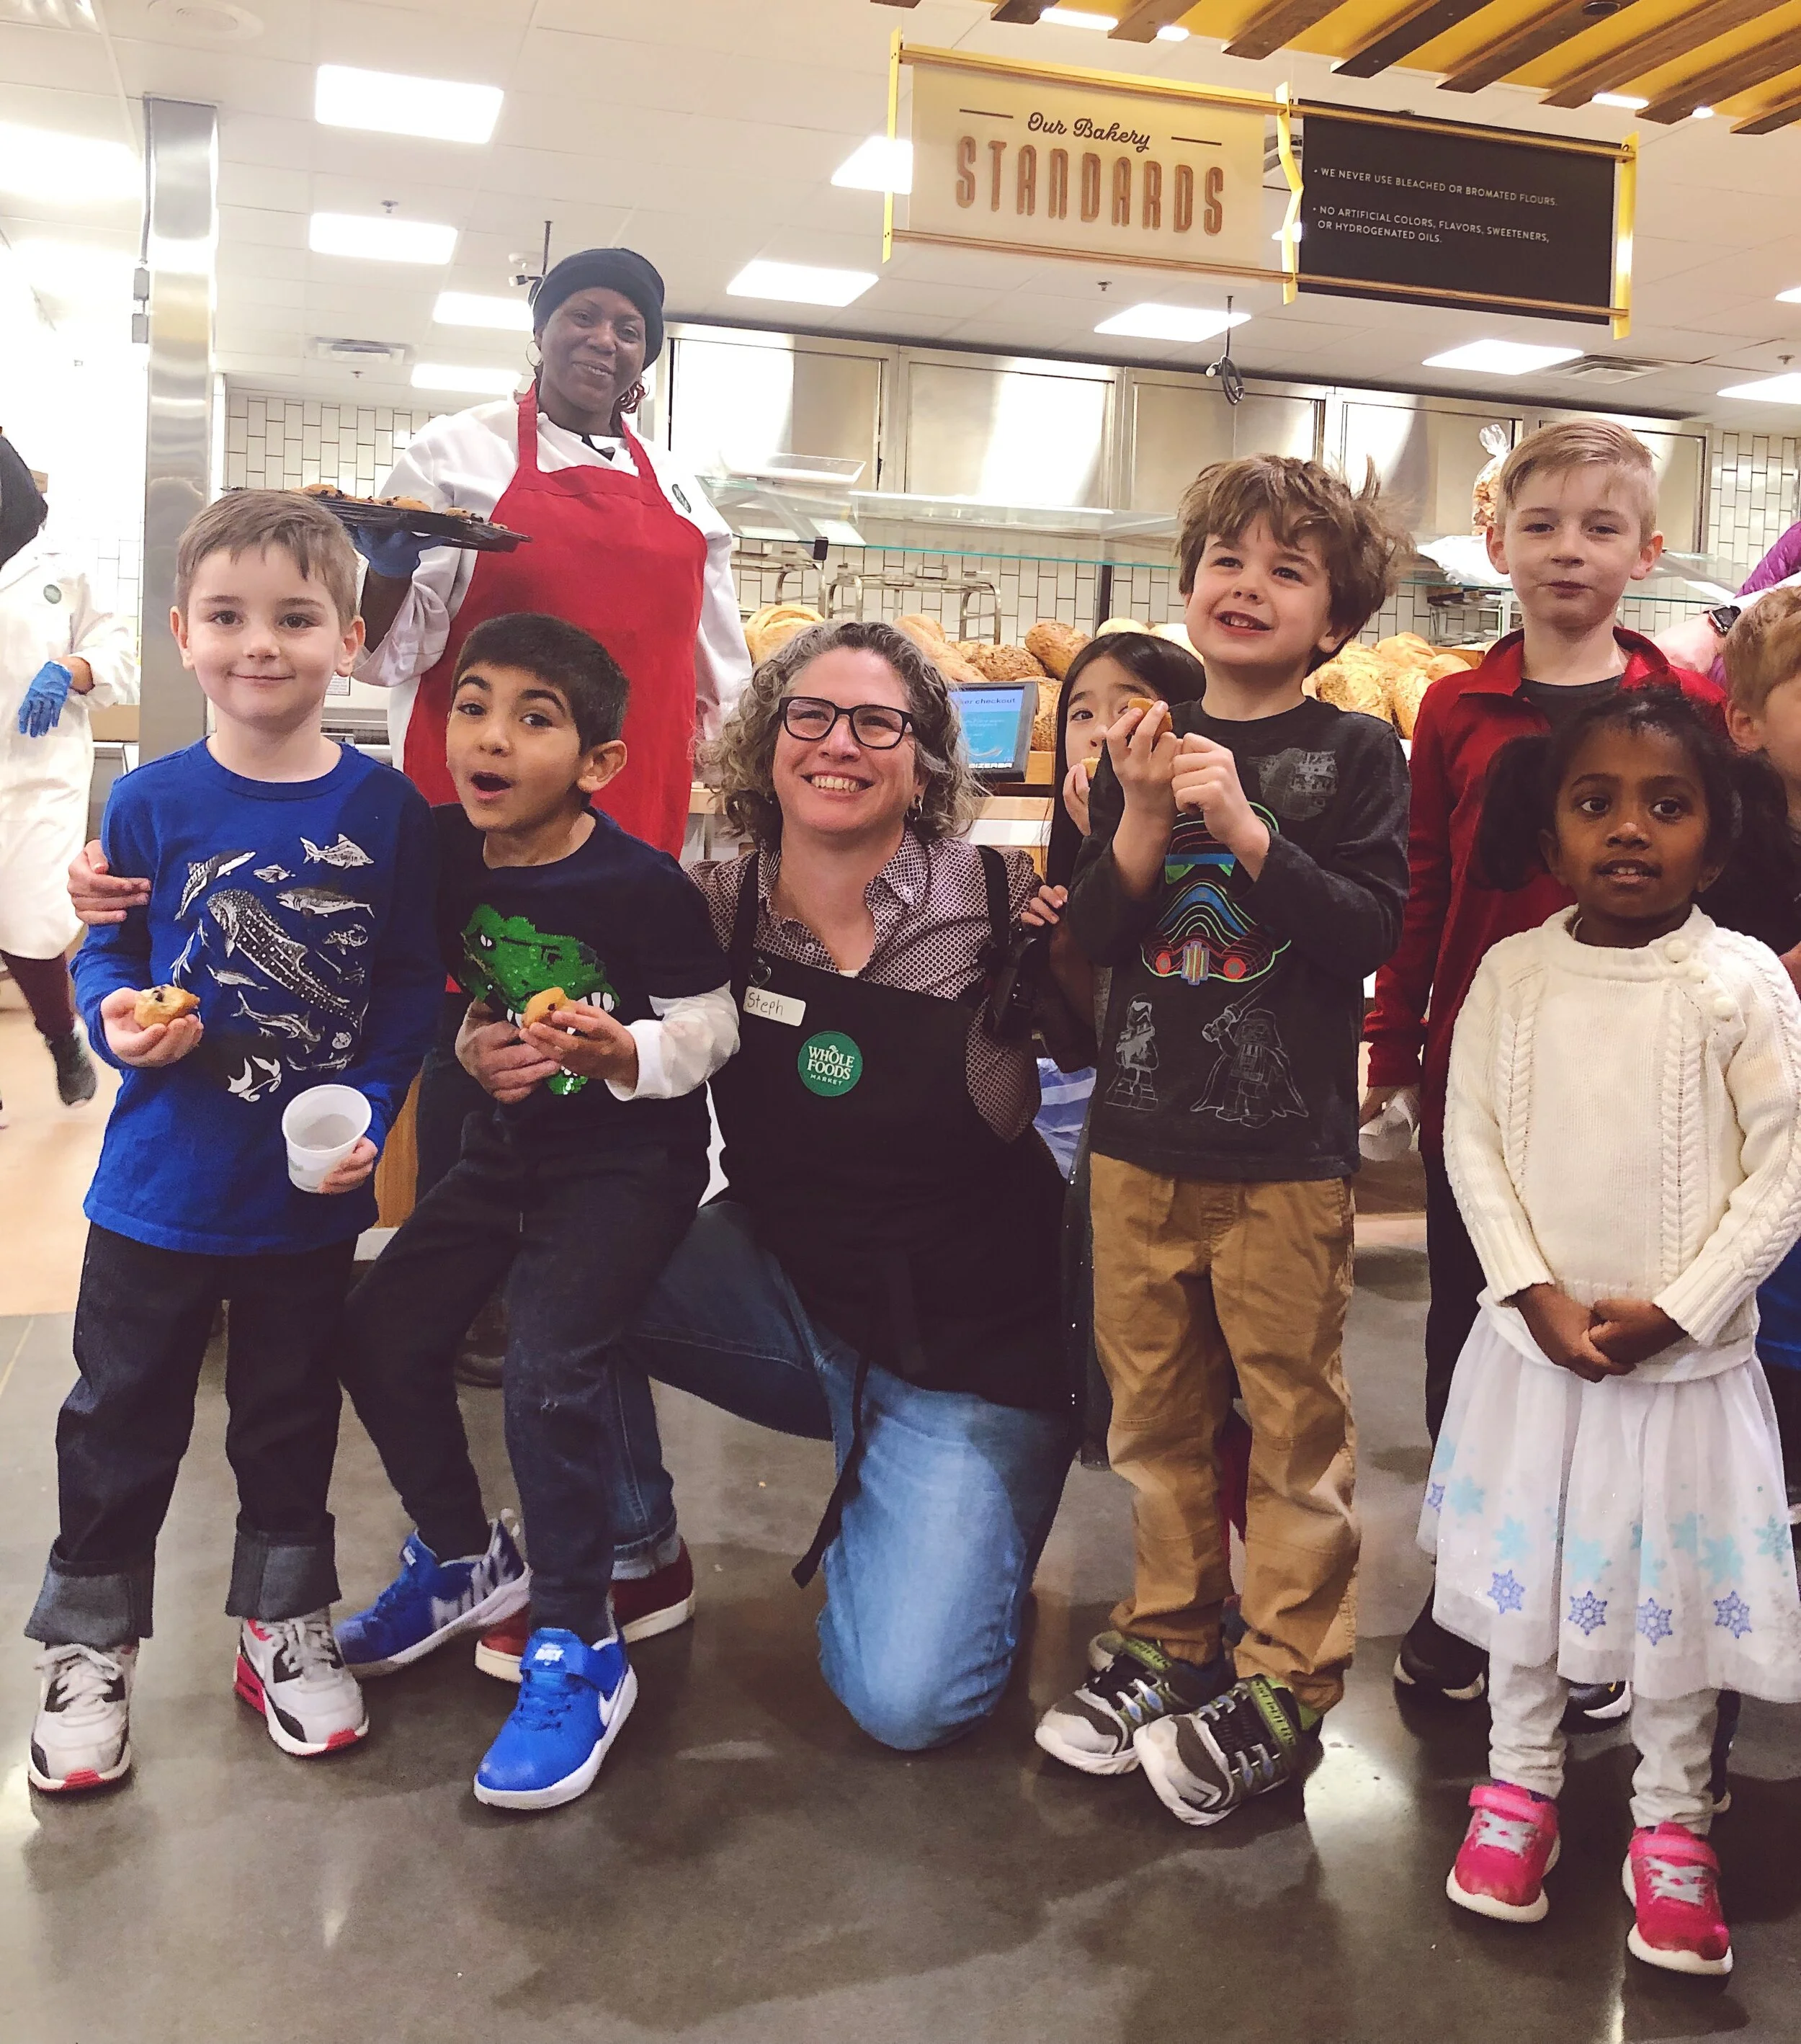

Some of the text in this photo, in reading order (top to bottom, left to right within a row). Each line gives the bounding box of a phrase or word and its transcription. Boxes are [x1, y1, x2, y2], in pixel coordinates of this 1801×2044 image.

[1027, 111, 1151, 153] Our Bakery
[955, 135, 1224, 236] STANDARDS
[1320, 167, 1558, 206] WE NEVER USE BLEACHED OR BROMATED FLOURS.
[1317, 220, 1442, 244] OR HYDROGENATED OILS.
[1320, 205, 1550, 244] NO ARTIFICIAL COLORS, FLAVORS, SWEETENERS,
[747, 992, 784, 1016] Steph
[808, 1045, 854, 1068] WHOLE
[807, 1058, 852, 1080] FOODS
[810, 1074, 843, 1086] MARKET
